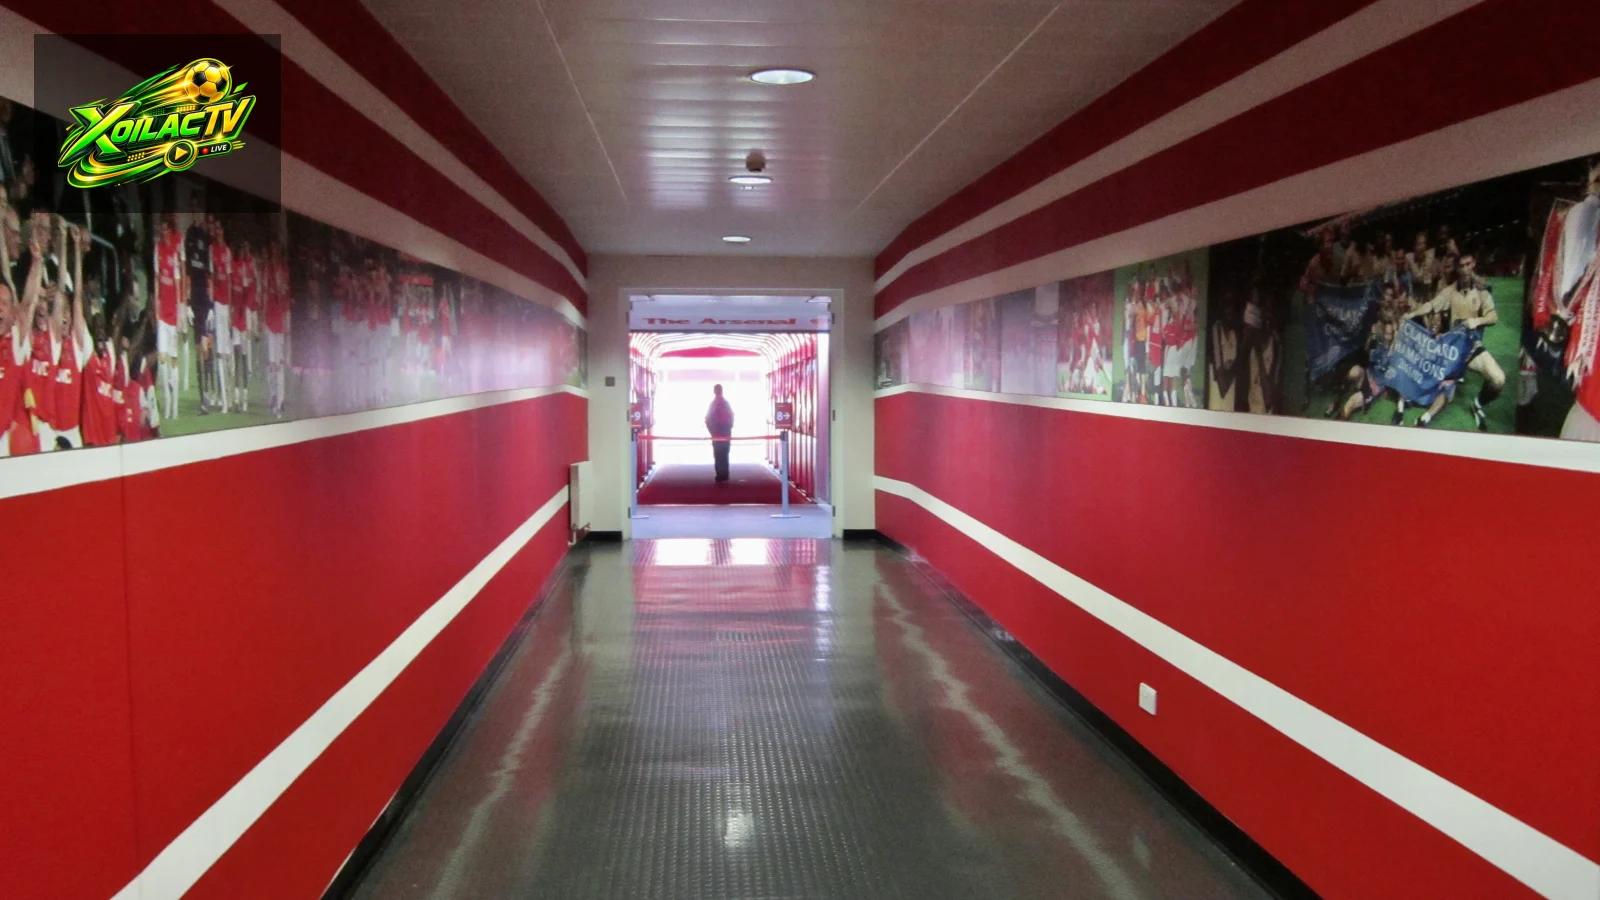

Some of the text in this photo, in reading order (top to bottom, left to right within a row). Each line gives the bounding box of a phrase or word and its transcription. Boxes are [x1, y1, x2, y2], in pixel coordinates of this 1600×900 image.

[642, 317, 797, 325] The Arsenal
[634, 411, 641, 421] 9
[776, 411, 784, 421] 8
